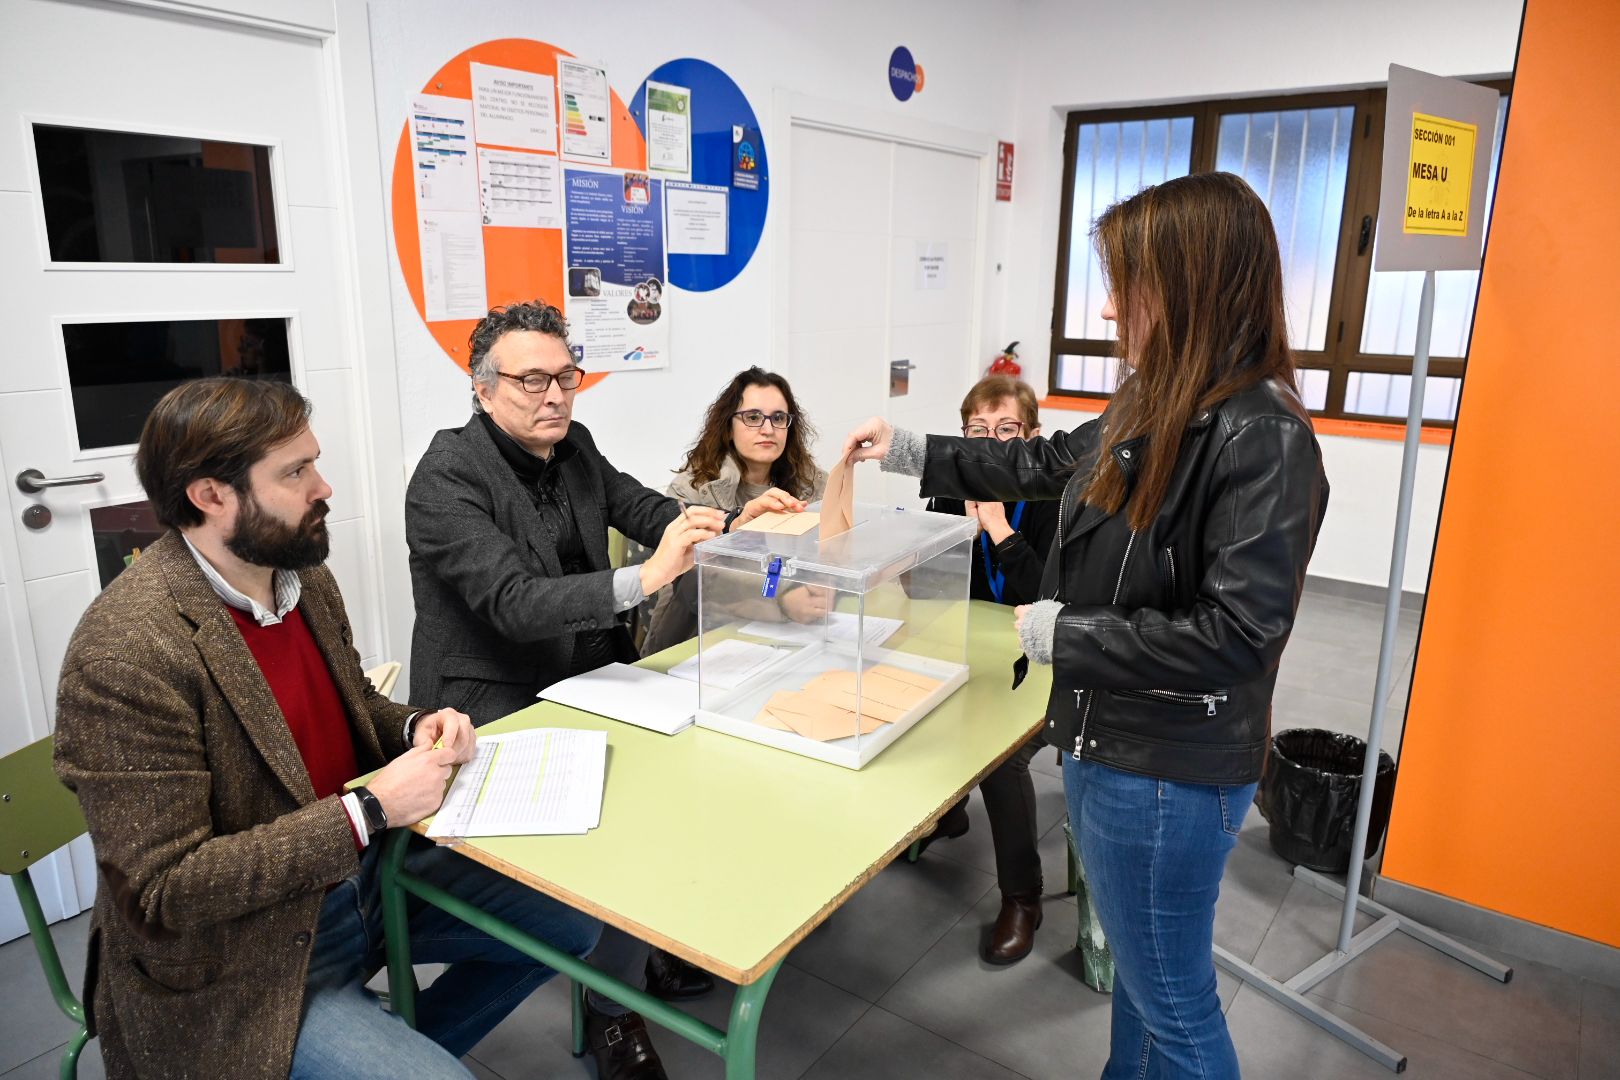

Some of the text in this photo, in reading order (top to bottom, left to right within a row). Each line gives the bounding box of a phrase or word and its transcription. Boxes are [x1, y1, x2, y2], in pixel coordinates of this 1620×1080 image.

[1414, 128, 1456, 147] SECCIÓN 001
[1412, 162, 1448, 183] MESA U
[572, 177, 599, 189] MISIÓN
[621, 204, 644, 214] VISIÓN
[1407, 206, 1417, 218] De
[1418, 207, 1424, 218] la
[1425, 207, 1440, 220] letra
[1441, 209, 1446, 220] A
[1452, 209, 1458, 221] la
[1459, 210, 1463, 221] Z
[602, 289, 633, 297] VALORES
